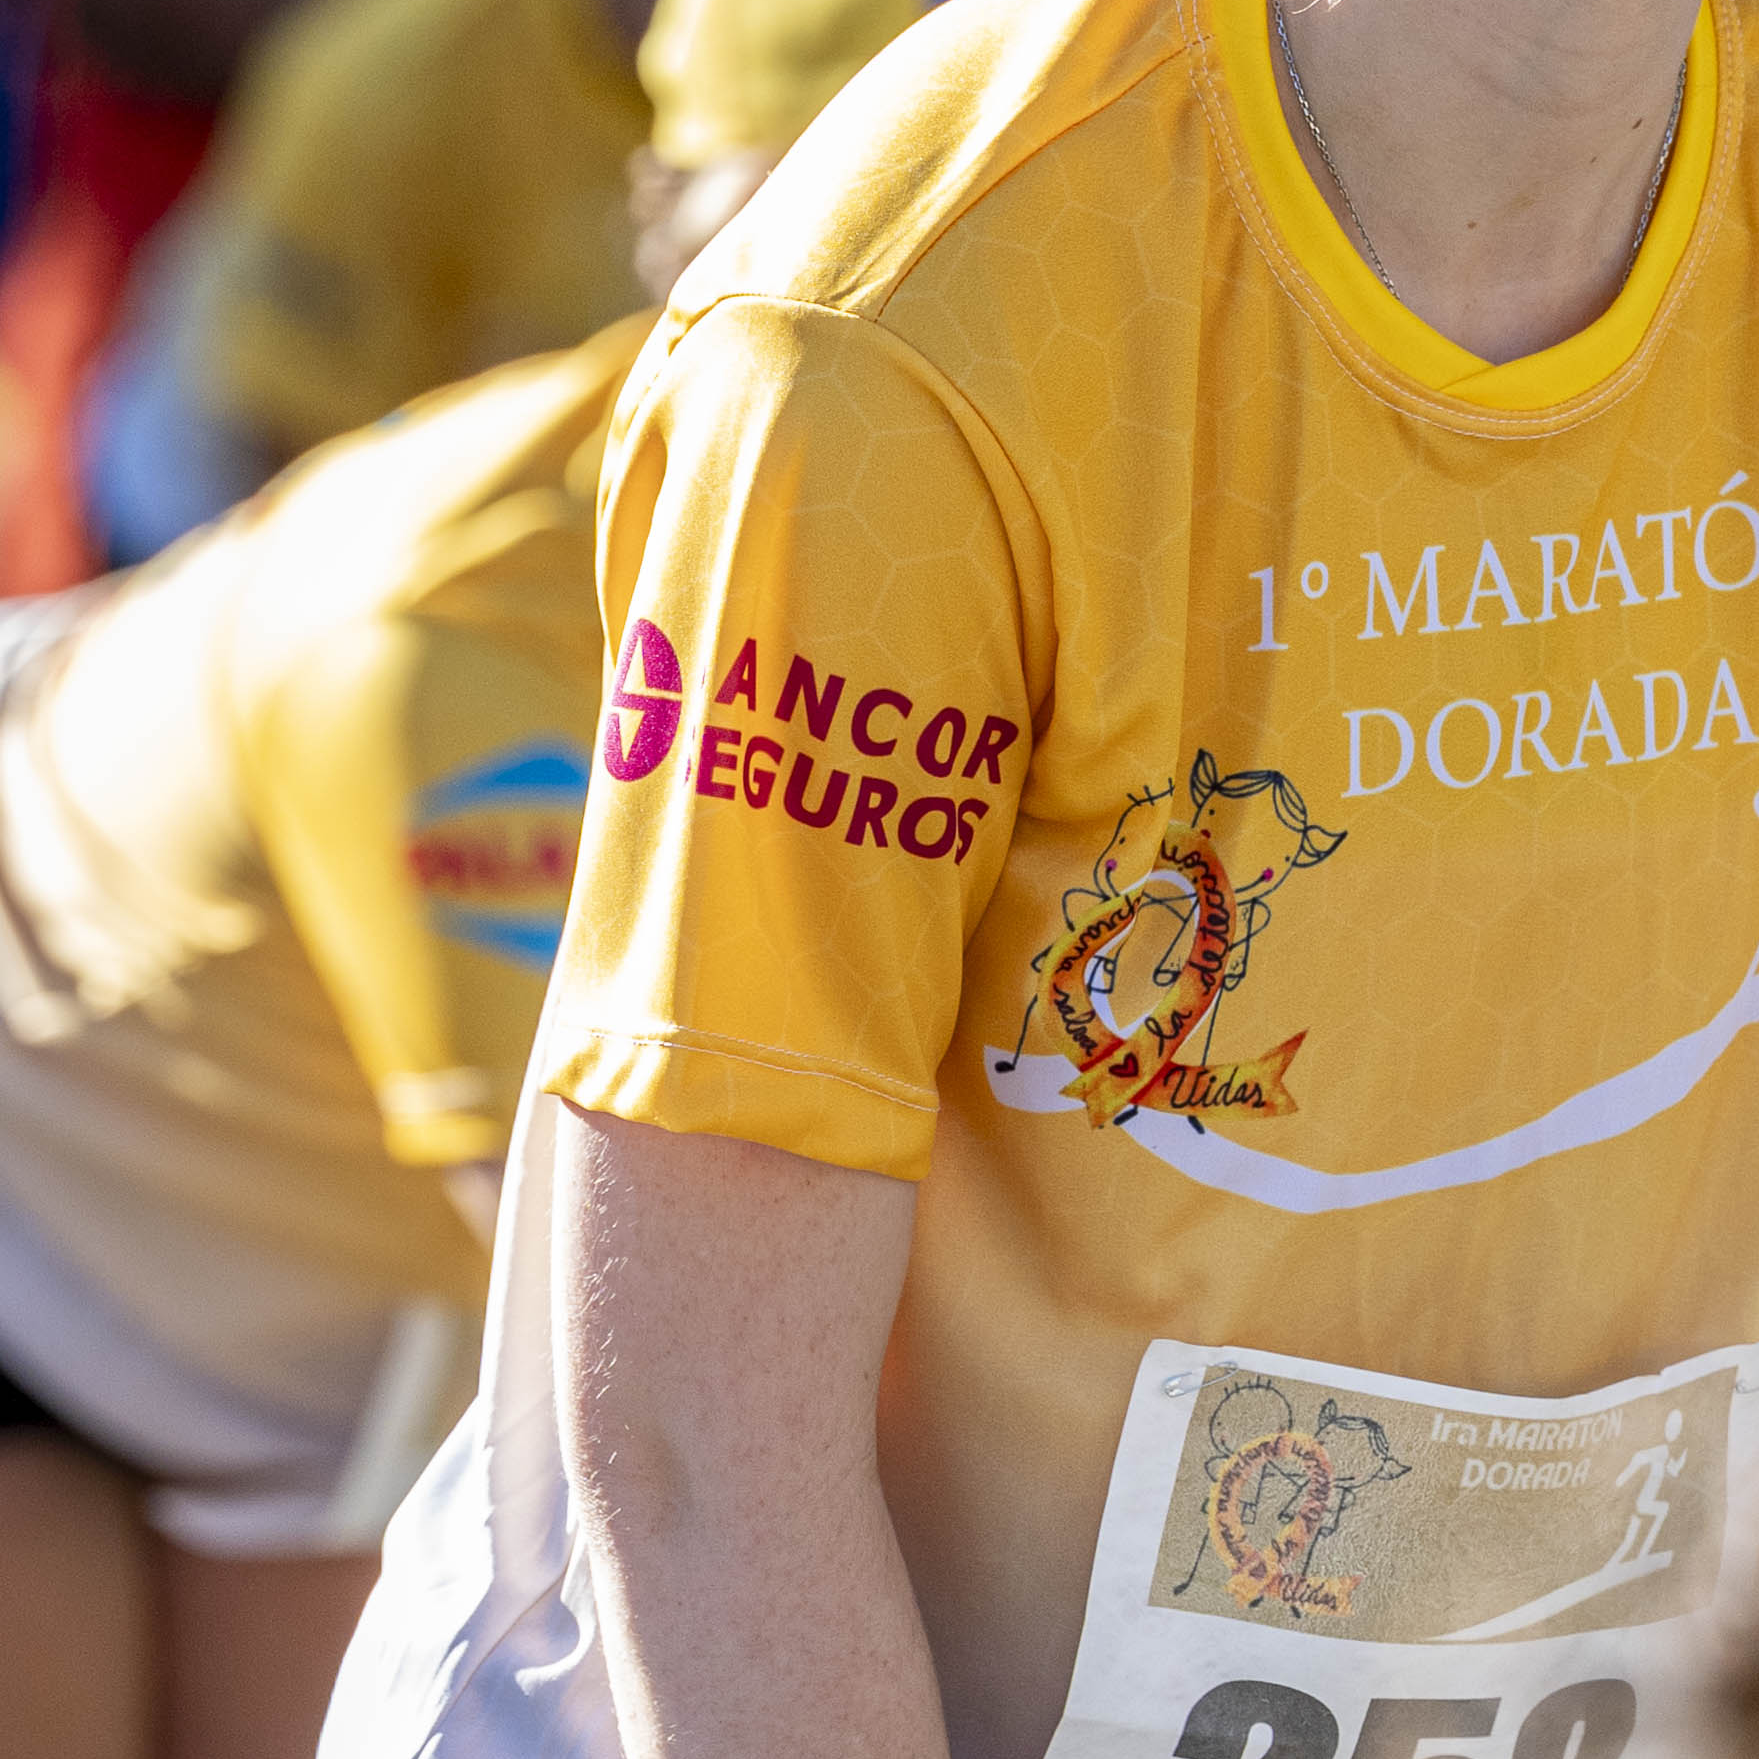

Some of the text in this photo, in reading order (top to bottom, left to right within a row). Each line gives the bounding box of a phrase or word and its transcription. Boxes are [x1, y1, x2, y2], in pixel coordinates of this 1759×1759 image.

[701, 637, 1020, 785] ANCOR
[686, 722, 990, 866] EGUROS
[1459, 1457, 1592, 1491] DORADA
